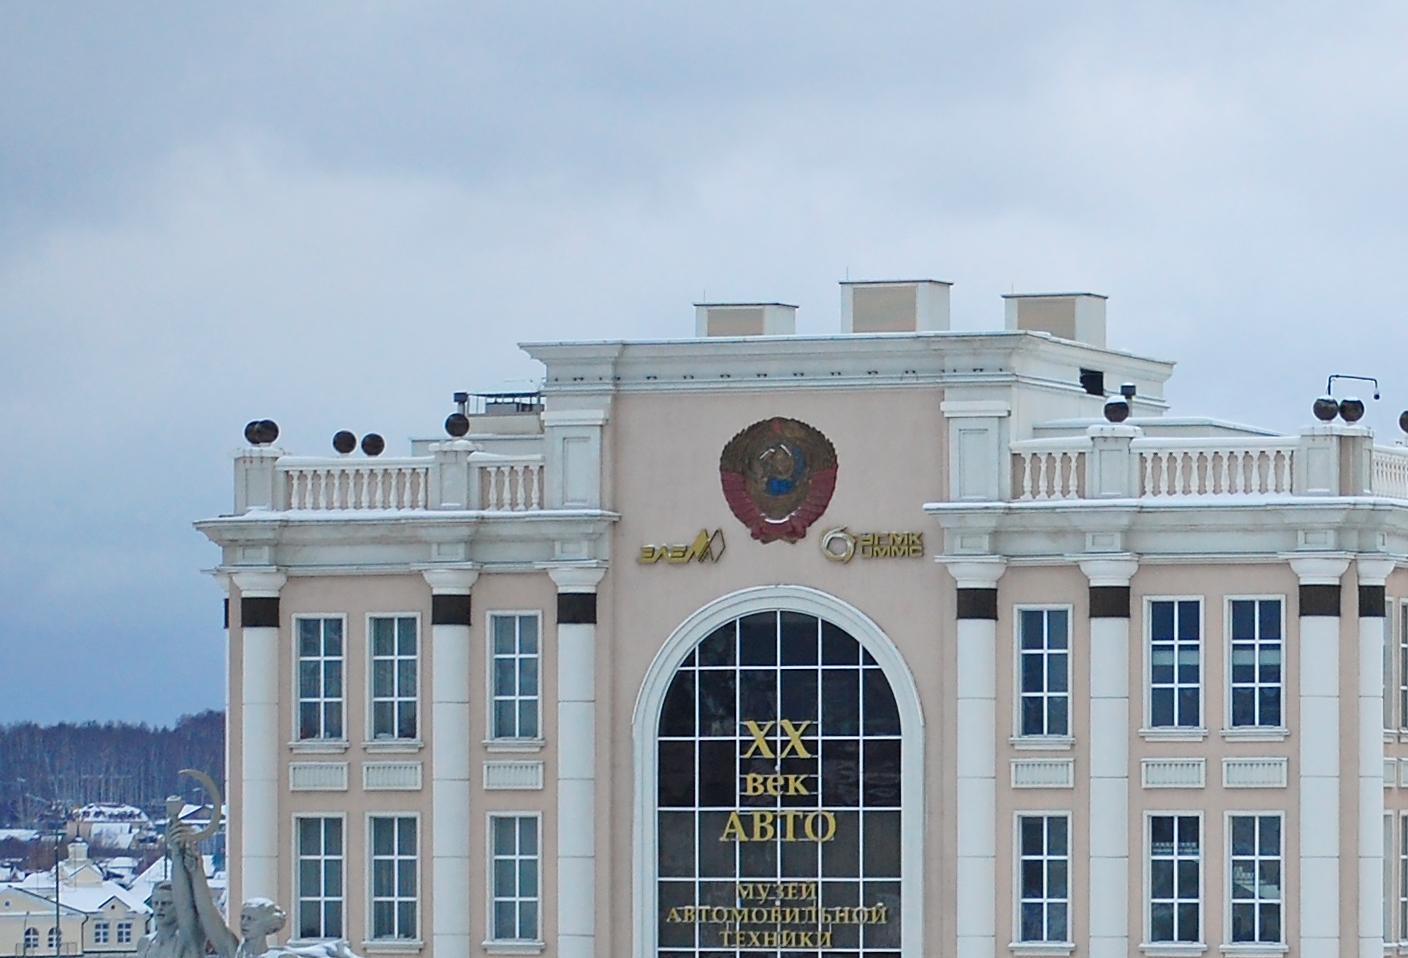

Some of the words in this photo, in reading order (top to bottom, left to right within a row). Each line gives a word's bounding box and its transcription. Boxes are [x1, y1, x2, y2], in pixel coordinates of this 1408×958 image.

[719, 809, 837, 842] АВТО
[737, 881, 817, 904] МУЗЕЙ
[666, 904, 888, 924] АВТОМОБИЛЬНОЙ
[719, 930, 833, 948] ТЕХНИКИ
